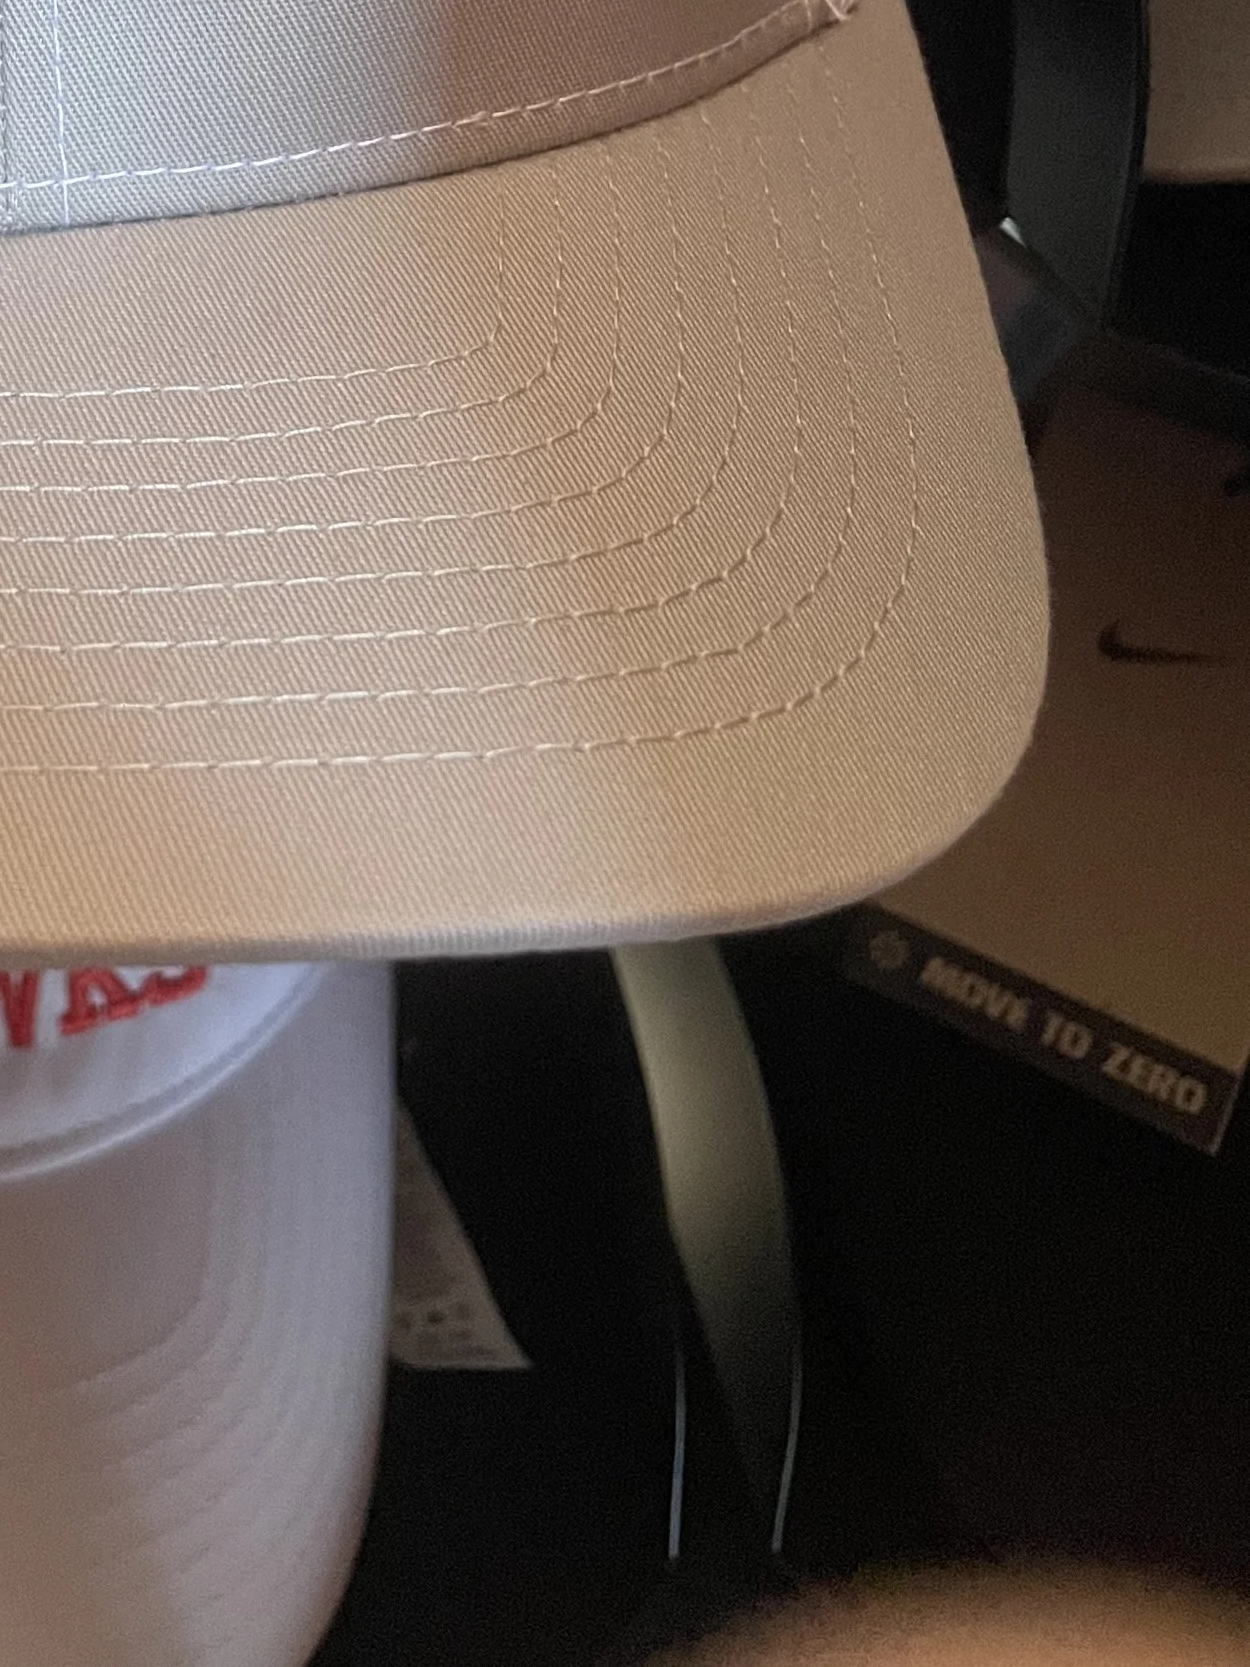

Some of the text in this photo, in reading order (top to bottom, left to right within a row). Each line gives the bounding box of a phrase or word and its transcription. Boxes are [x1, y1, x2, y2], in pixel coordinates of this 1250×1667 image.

[918, 955, 1209, 1116] MOVE TO ZERO
